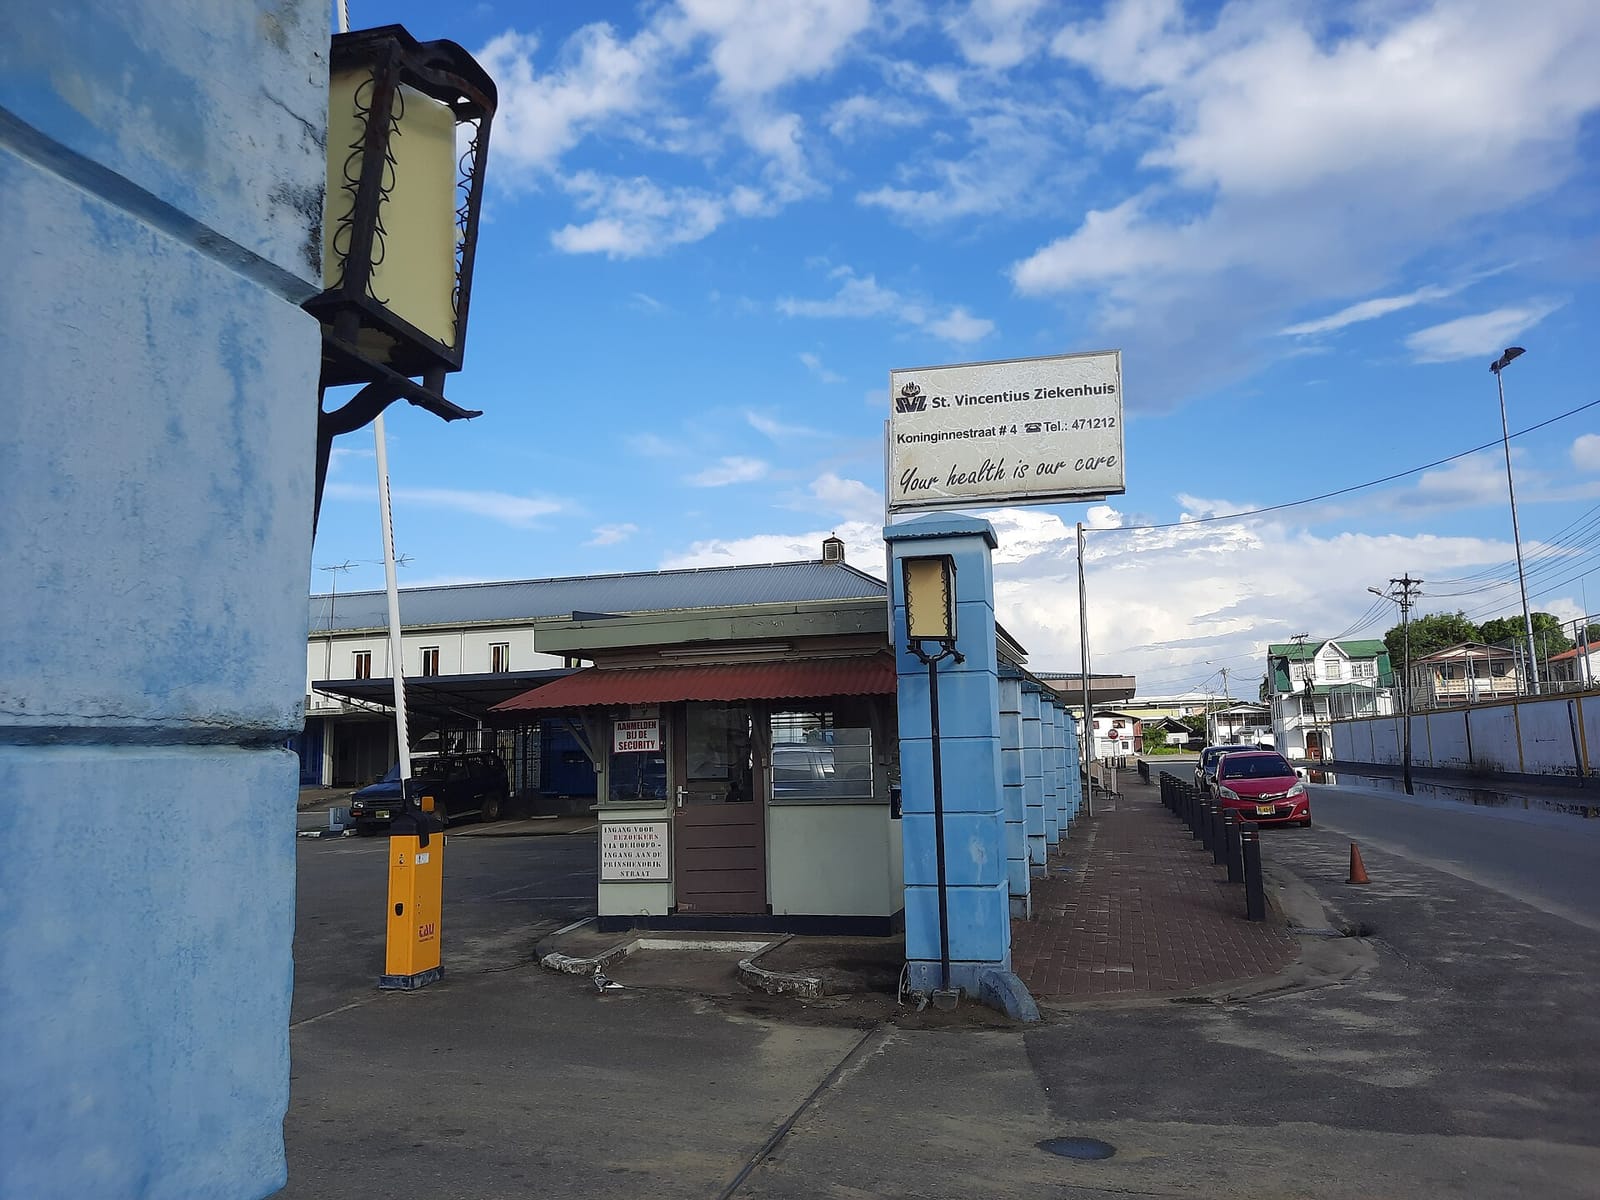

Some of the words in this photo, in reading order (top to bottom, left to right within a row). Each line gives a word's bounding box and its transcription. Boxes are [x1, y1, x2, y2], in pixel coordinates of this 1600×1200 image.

[932, 396, 951, 409] St.
[955, 389, 1030, 407] Vincentius
[1034, 382, 1116, 400] Ziekenhuis
[896, 426, 997, 444] Koninginnestraat
[1043, 420, 1068, 433] Tel.:
[1071, 417, 1116, 430] 471212
[899, 467, 939, 494] Your
[946, 457, 1005, 487] health
[1013, 459, 1029, 479] is
[1036, 460, 1067, 475] our
[1075, 455, 1118, 471] care
[617, 720, 657, 731] AANMELDEN
[626, 731, 637, 740] BIJ
[638, 730, 648, 739] DE
[618, 740, 656, 751] SECURITY
